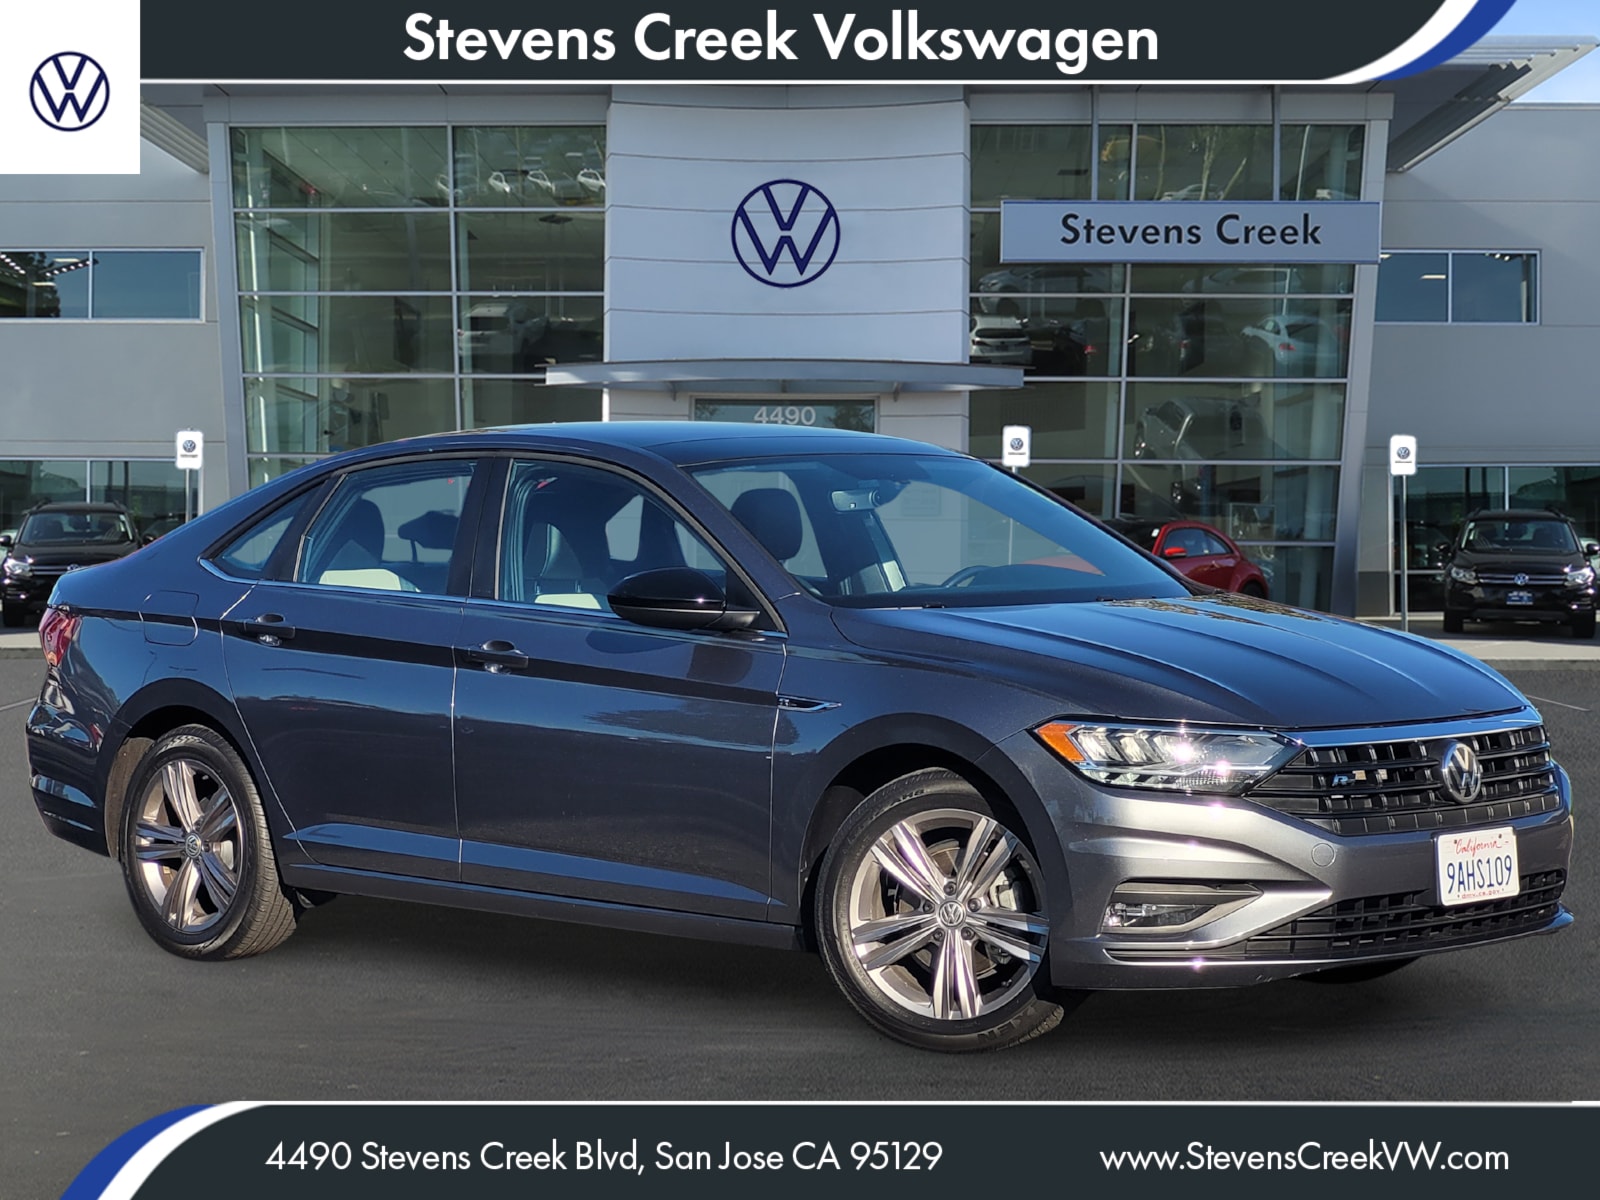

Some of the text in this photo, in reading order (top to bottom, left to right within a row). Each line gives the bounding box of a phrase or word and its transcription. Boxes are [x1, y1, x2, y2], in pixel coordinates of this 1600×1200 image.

[732, 180, 839, 287] VW
[1060, 212, 1321, 245] Stevens Creek
[754, 406, 816, 425] 4490
[1456, 836, 1503, 857] California
[1446, 854, 1512, 894] 9AHS109
